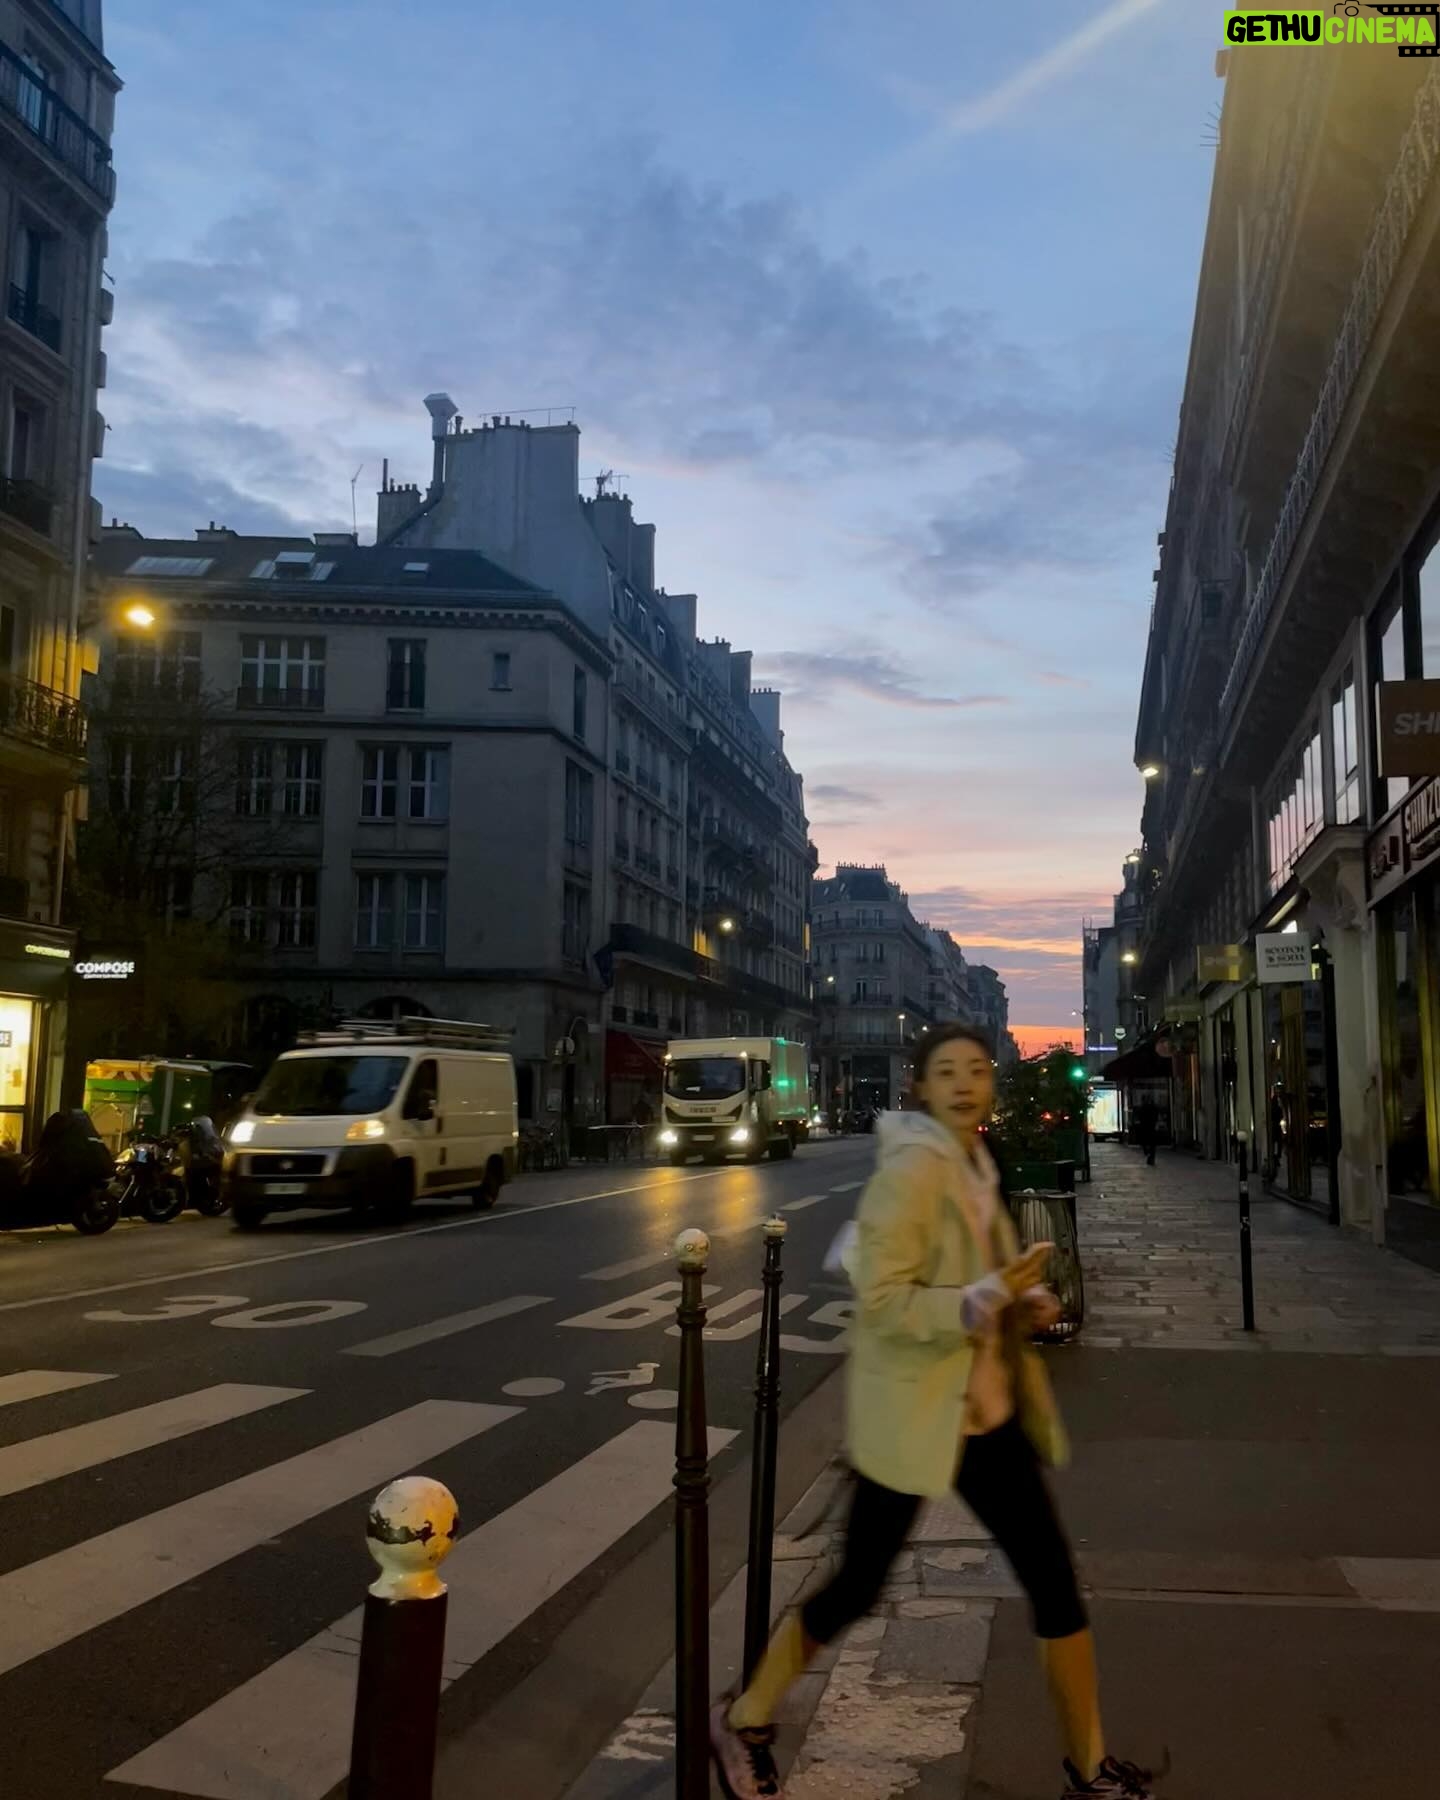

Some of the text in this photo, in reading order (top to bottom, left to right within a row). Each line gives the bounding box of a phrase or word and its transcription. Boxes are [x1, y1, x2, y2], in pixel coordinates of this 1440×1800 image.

[75, 961, 135, 974] COMPOSE
[83, 1295, 368, 1329] 30
[555, 1281, 856, 1354] BUS
